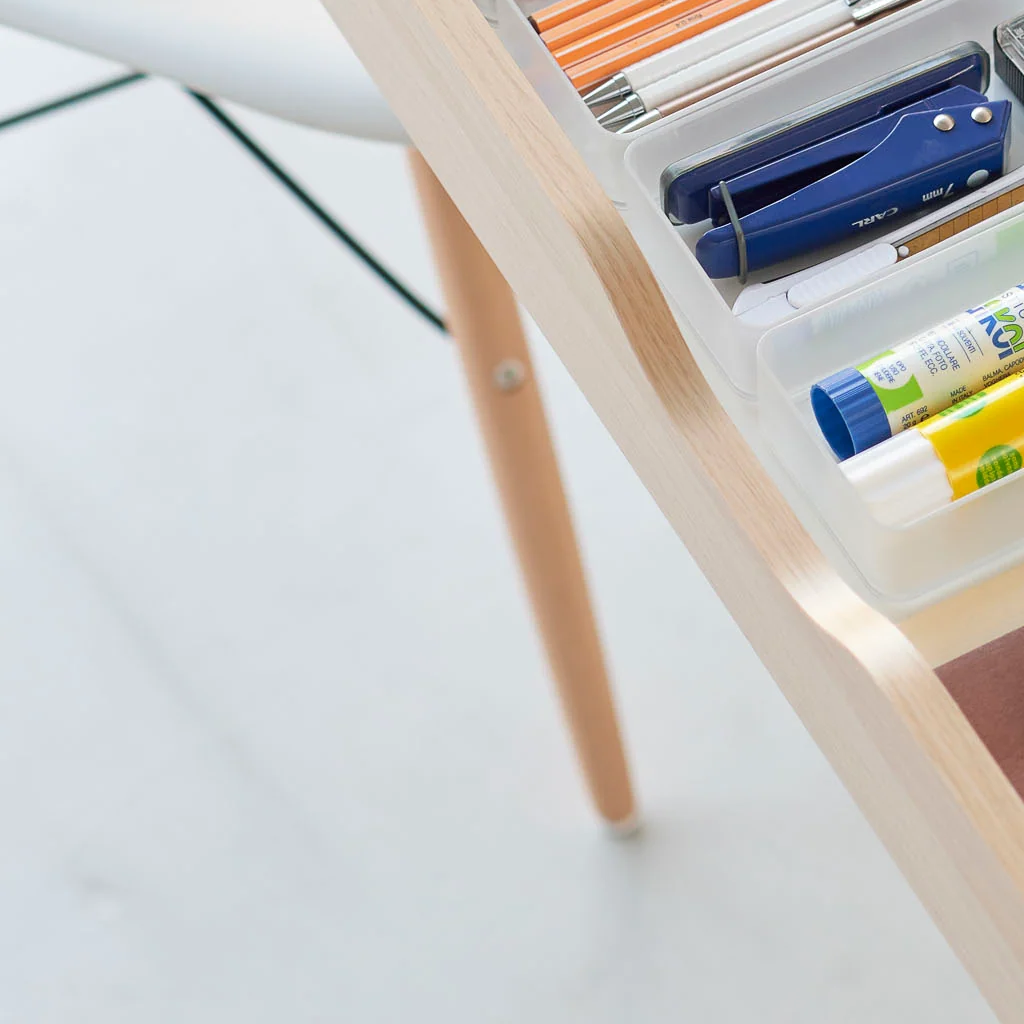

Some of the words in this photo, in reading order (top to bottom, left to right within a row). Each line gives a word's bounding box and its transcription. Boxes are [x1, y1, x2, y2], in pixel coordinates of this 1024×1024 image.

[851, 207, 899, 228] CARL
[934, 352, 948, 371] FOTO
[950, 385, 967, 397] MADE
[901, 412, 915, 424] ART.
